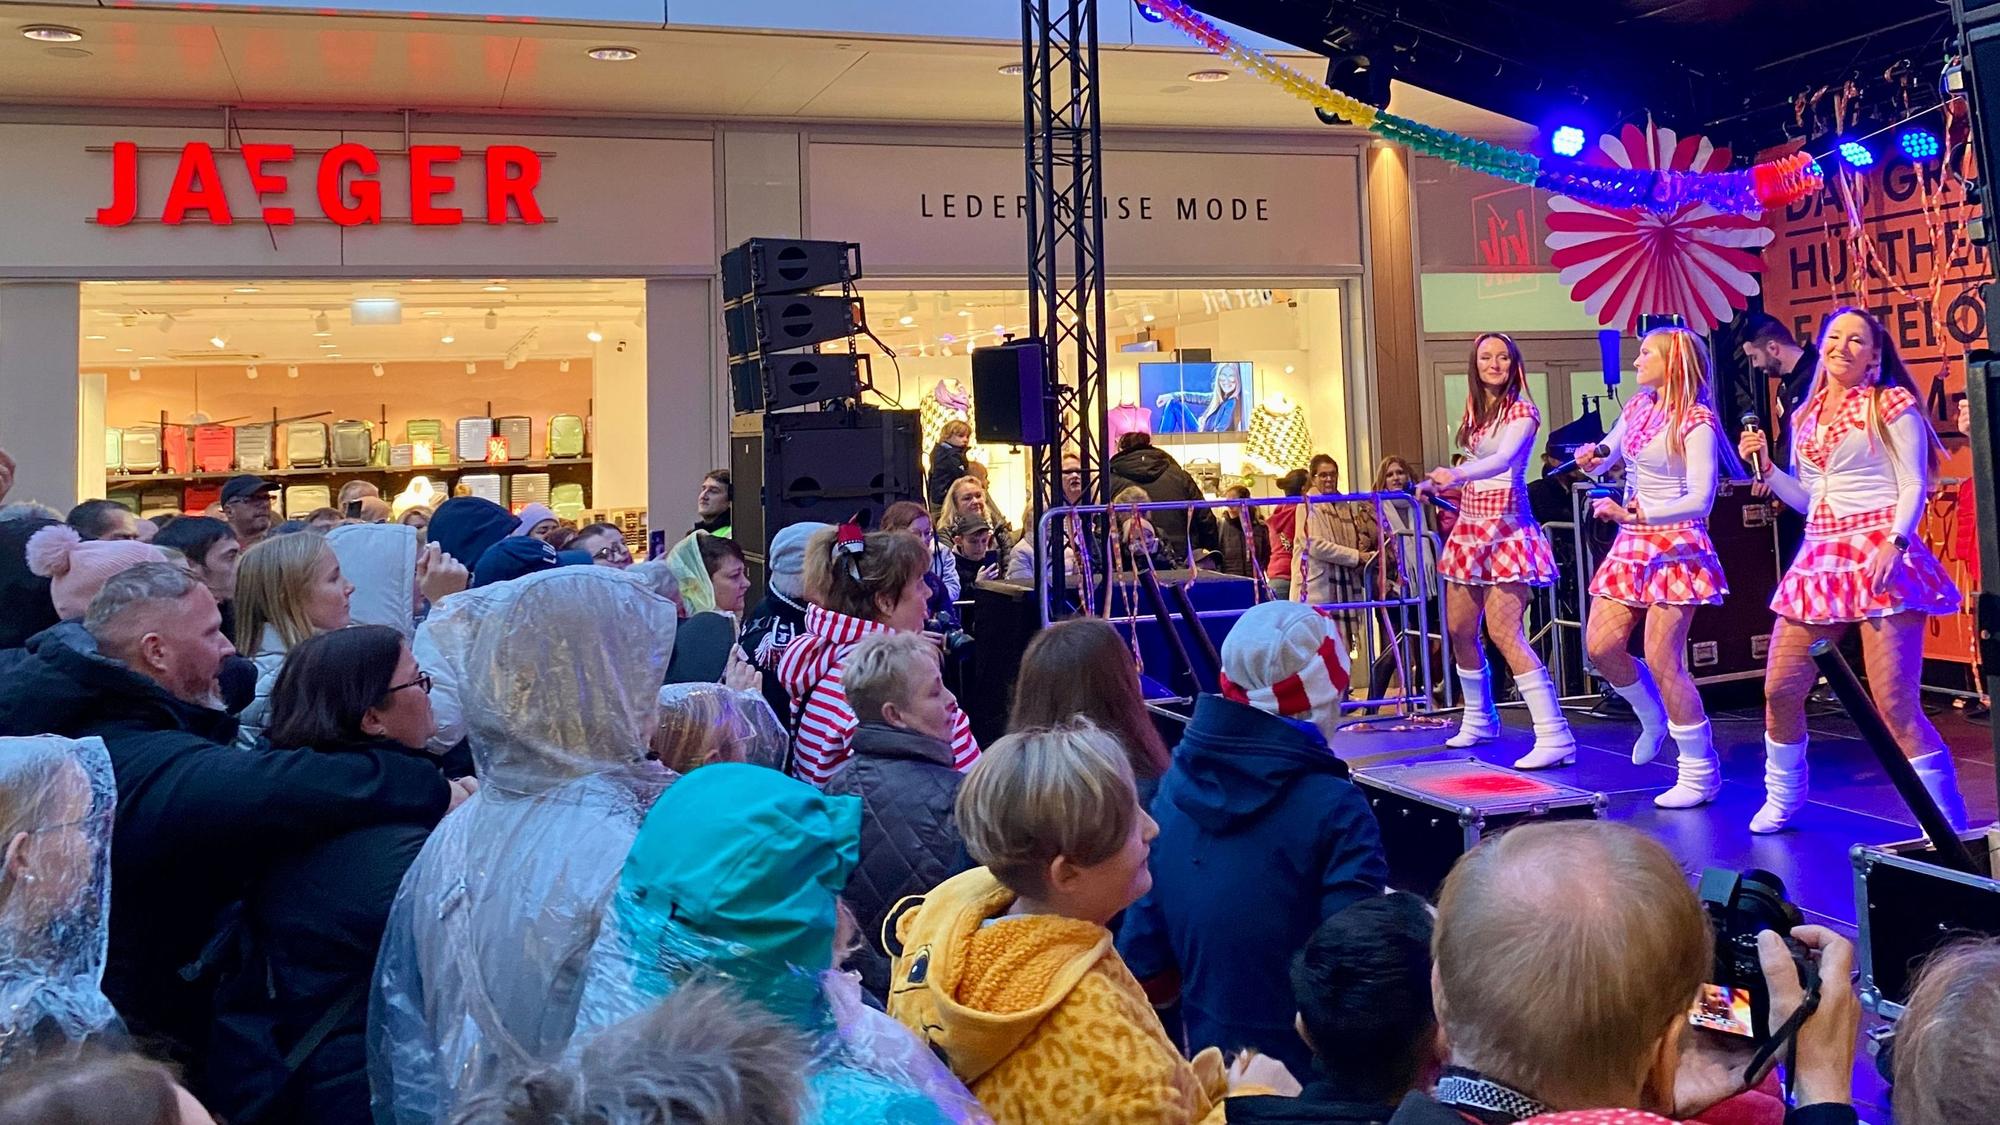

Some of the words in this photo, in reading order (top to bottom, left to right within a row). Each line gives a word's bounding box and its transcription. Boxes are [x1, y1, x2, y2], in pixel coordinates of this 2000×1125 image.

[97, 141, 546, 227] JAEGER
[920, 193, 1029, 219] LEDER
[1056, 195, 1153, 220] REISE
[1176, 197, 1269, 221] MODE
[1794, 294, 1985, 350] FTELO
